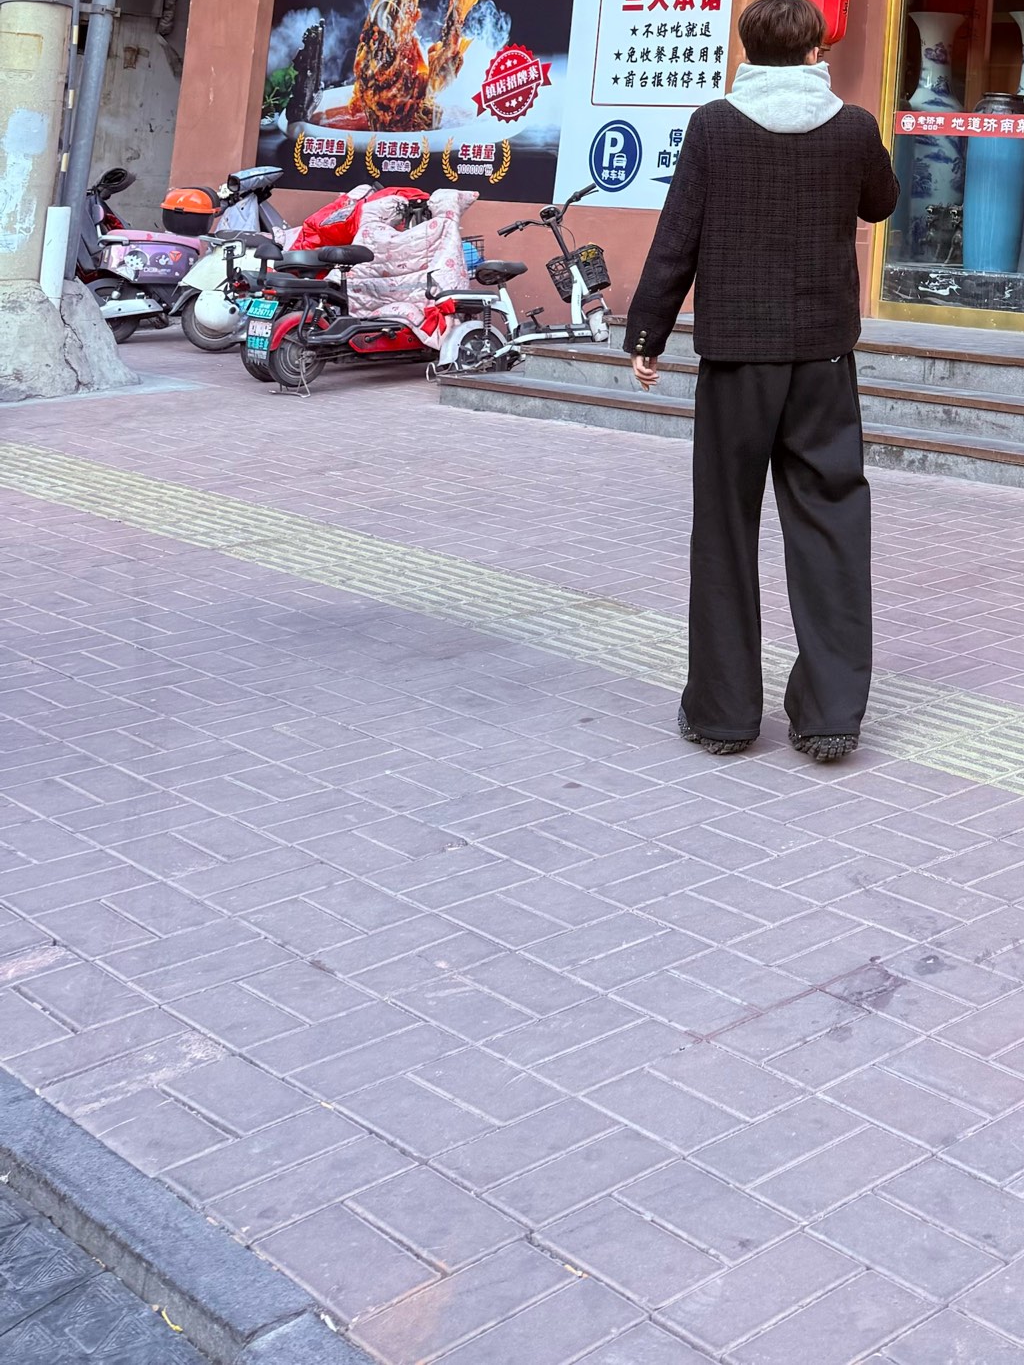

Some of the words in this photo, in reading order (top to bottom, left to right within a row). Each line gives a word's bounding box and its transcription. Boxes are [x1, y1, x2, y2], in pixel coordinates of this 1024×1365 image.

[642, 21, 712, 38] 不好吃就退
[626, 45, 724, 63] 免收餐具使用费
[624, 70, 722, 88] 前台报销停车费
[376, 141, 421, 158] 非遗传承
[458, 143, 495, 162] 年销量
